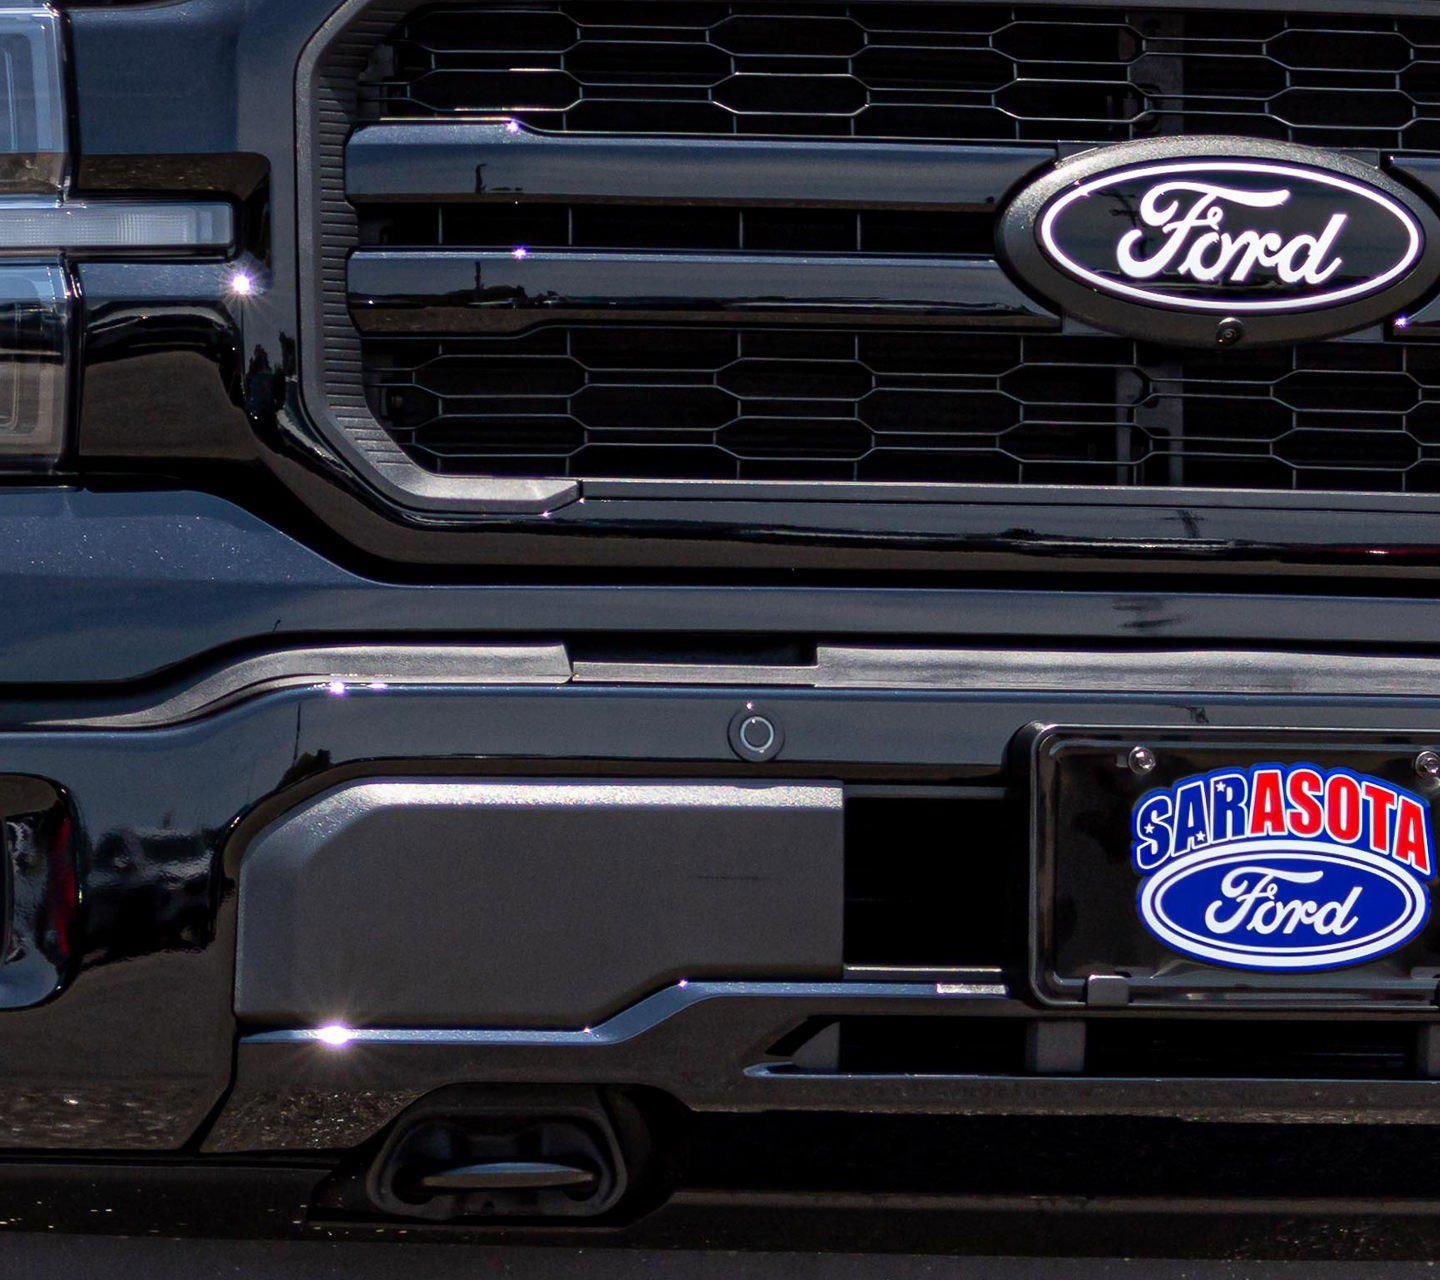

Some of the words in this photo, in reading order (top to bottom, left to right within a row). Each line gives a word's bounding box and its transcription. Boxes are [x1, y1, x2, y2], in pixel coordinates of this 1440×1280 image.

[1116, 181, 1349, 285] Ford
[1136, 767, 1433, 877] SARASOTA
[1204, 866, 1363, 936] Ford
